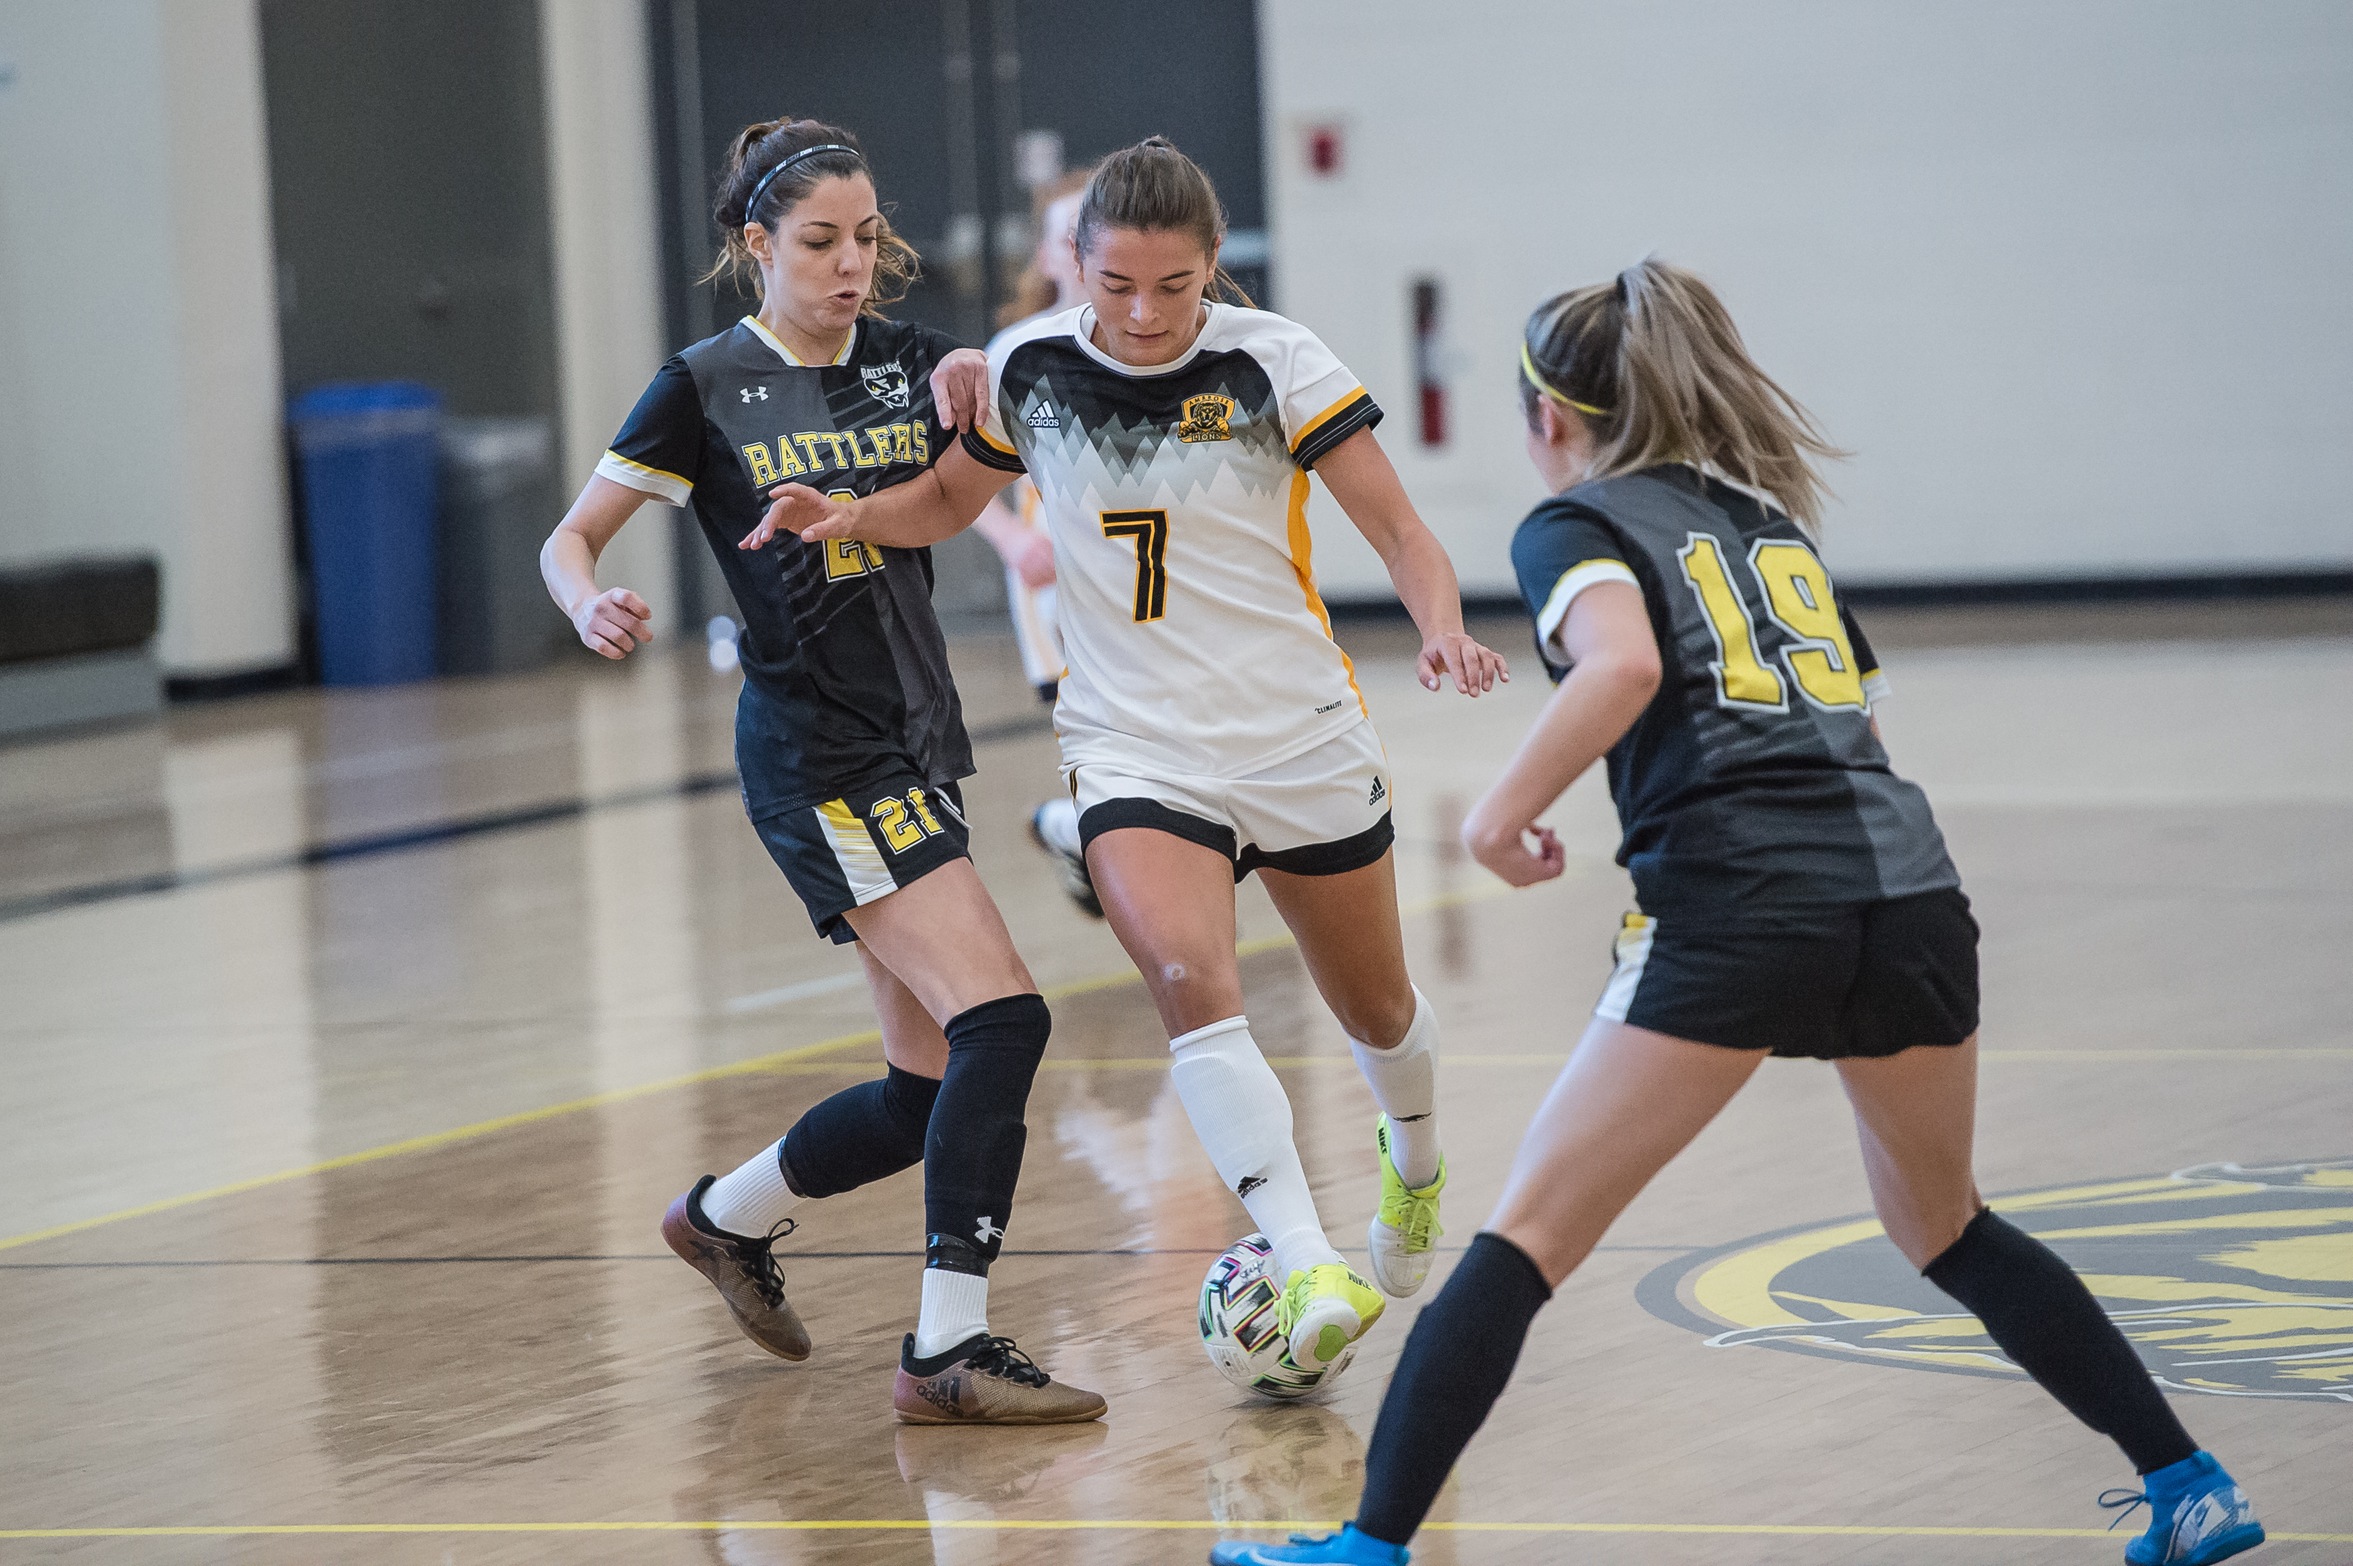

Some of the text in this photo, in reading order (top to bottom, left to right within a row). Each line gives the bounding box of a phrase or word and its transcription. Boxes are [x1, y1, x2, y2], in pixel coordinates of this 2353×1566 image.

[1028, 417, 1060, 428] adidas
[1192, 433, 1221, 441] LIONS
[742, 420, 929, 488] RATTLERS
[1099, 509, 1169, 624] 7
[1677, 531, 1871, 716] 19
[1317, 700, 1343, 714] CLIMALITE
[1369, 789, 1386, 806] adidas
[870, 787, 945, 855] 21
[1347, 1271, 1372, 1291] NIKE
[916, 1383, 965, 1417] adidas
